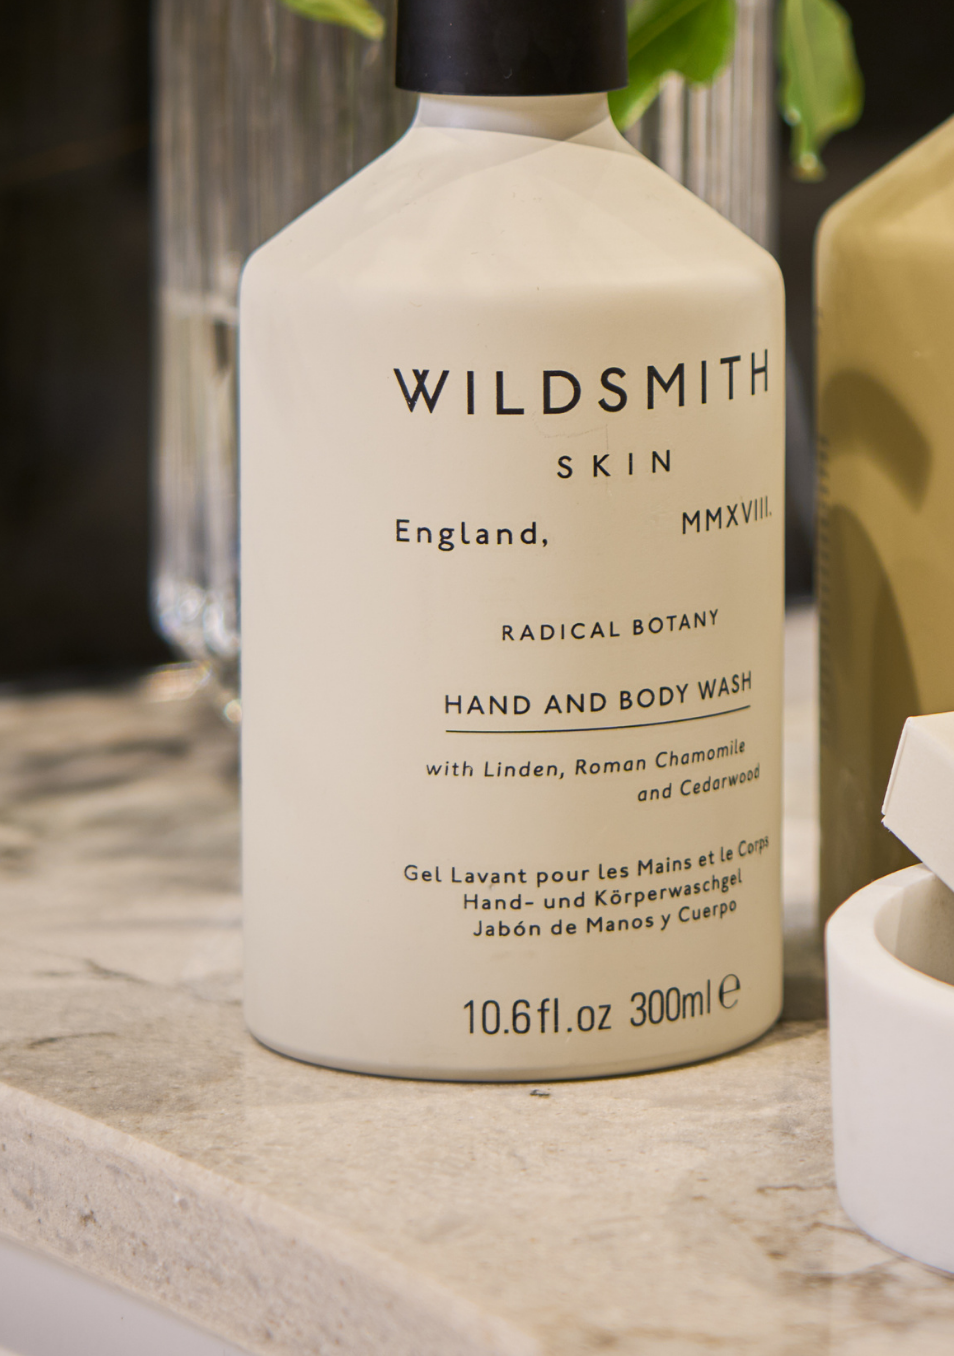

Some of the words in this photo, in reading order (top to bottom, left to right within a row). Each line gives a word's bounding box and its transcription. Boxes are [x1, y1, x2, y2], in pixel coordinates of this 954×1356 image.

[393, 348, 770, 415] WILDSMITH
[556, 449, 672, 479] SKIN
[395, 518, 549, 552] England,
[681, 495, 772, 535] MMXVIII.
[501, 621, 621, 642] RADICAL
[632, 608, 720, 636] BOTANY
[444, 693, 532, 716] HAND
[543, 692, 608, 715] AND
[619, 683, 690, 711] BODY
[697, 670, 753, 701] WASH
[425, 760, 475, 778] with
[483, 760, 566, 780] Linden,
[574, 757, 647, 776] Roman
[655, 738, 747, 769] Chamomile
[636, 782, 673, 803] and
[679, 762, 761, 797] Cedarwood
[403, 864, 443, 884] Gel
[450, 866, 528, 885] Lavant
[536, 868, 590, 888] pour
[598, 863, 630, 881] les
[637, 856, 692, 877] Mains
[698, 850, 716, 868] et
[720, 846, 734, 864] le
[738, 835, 770, 858] Corps
[463, 892, 535, 911] Hand-
[543, 890, 586, 910] und
[594, 868, 743, 909] Körperwaschgel
[473, 919, 542, 938] Jabón
[550, 918, 577, 936] de
[586, 915, 655, 935] Manos
[660, 912, 672, 931] y
[677, 898, 738, 925] Cuerpo
